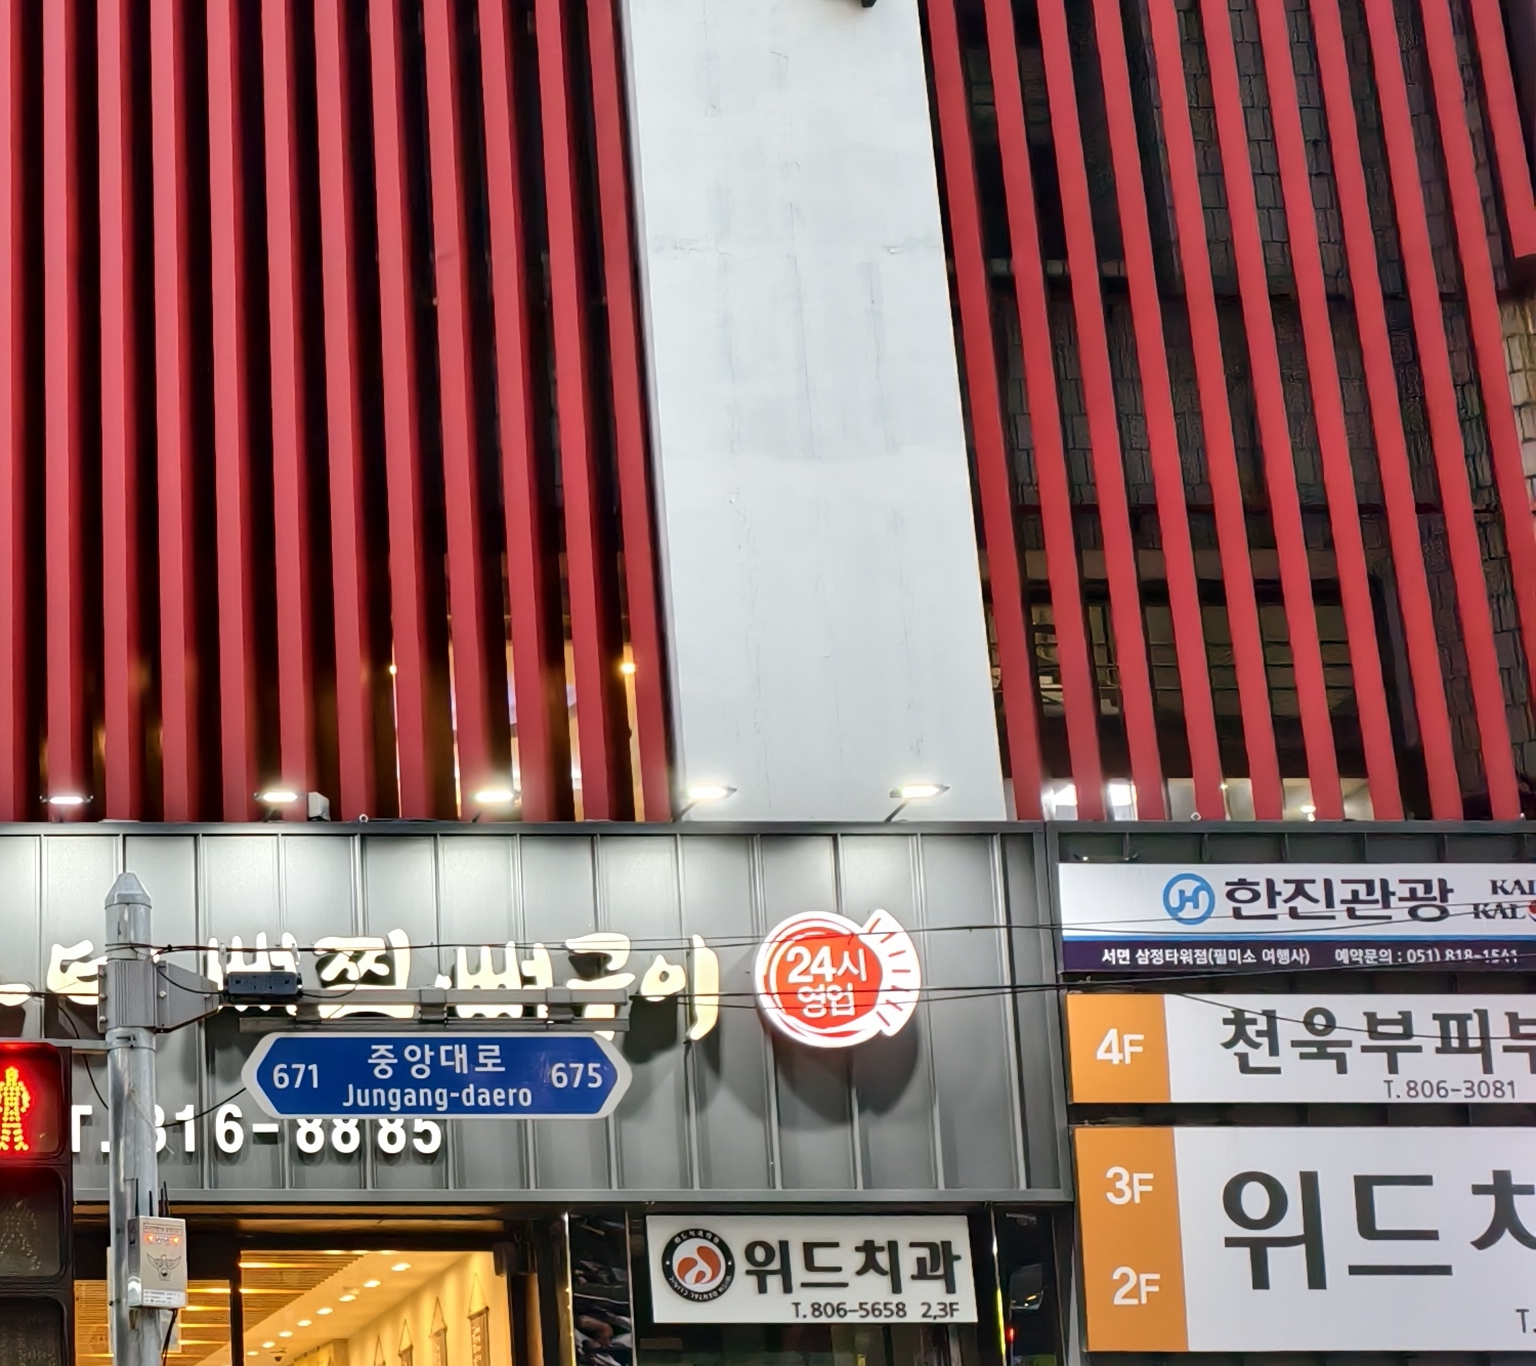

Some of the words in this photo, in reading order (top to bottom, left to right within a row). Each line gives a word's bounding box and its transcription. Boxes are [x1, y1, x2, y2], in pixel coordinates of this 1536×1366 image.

[1224, 877, 1455, 923] 한진관광
[1472, 902, 1527, 920] KAL
[785, 945, 870, 984] 24시
[1101, 948, 1131, 964] 서면
[1334, 947, 1393, 965] 예약문의
[796, 986, 856, 1018] 영업
[366, 1042, 507, 1080] 중앙대로
[1095, 1028, 1145, 1066] 4F
[272, 1063, 319, 1090] 671
[549, 1063, 604, 1089] 675
[1383, 1079, 1517, 1099] T.806-3081
[341, 1082, 533, 1113] Jungang-daero
[1105, 1165, 1155, 1206] 3F
[743, 1239, 963, 1295] 위드치과
[1112, 1266, 1162, 1306] 2F
[791, 1301, 908, 1319] T.806-5658
[920, 1301, 960, 1321] 2,3F
